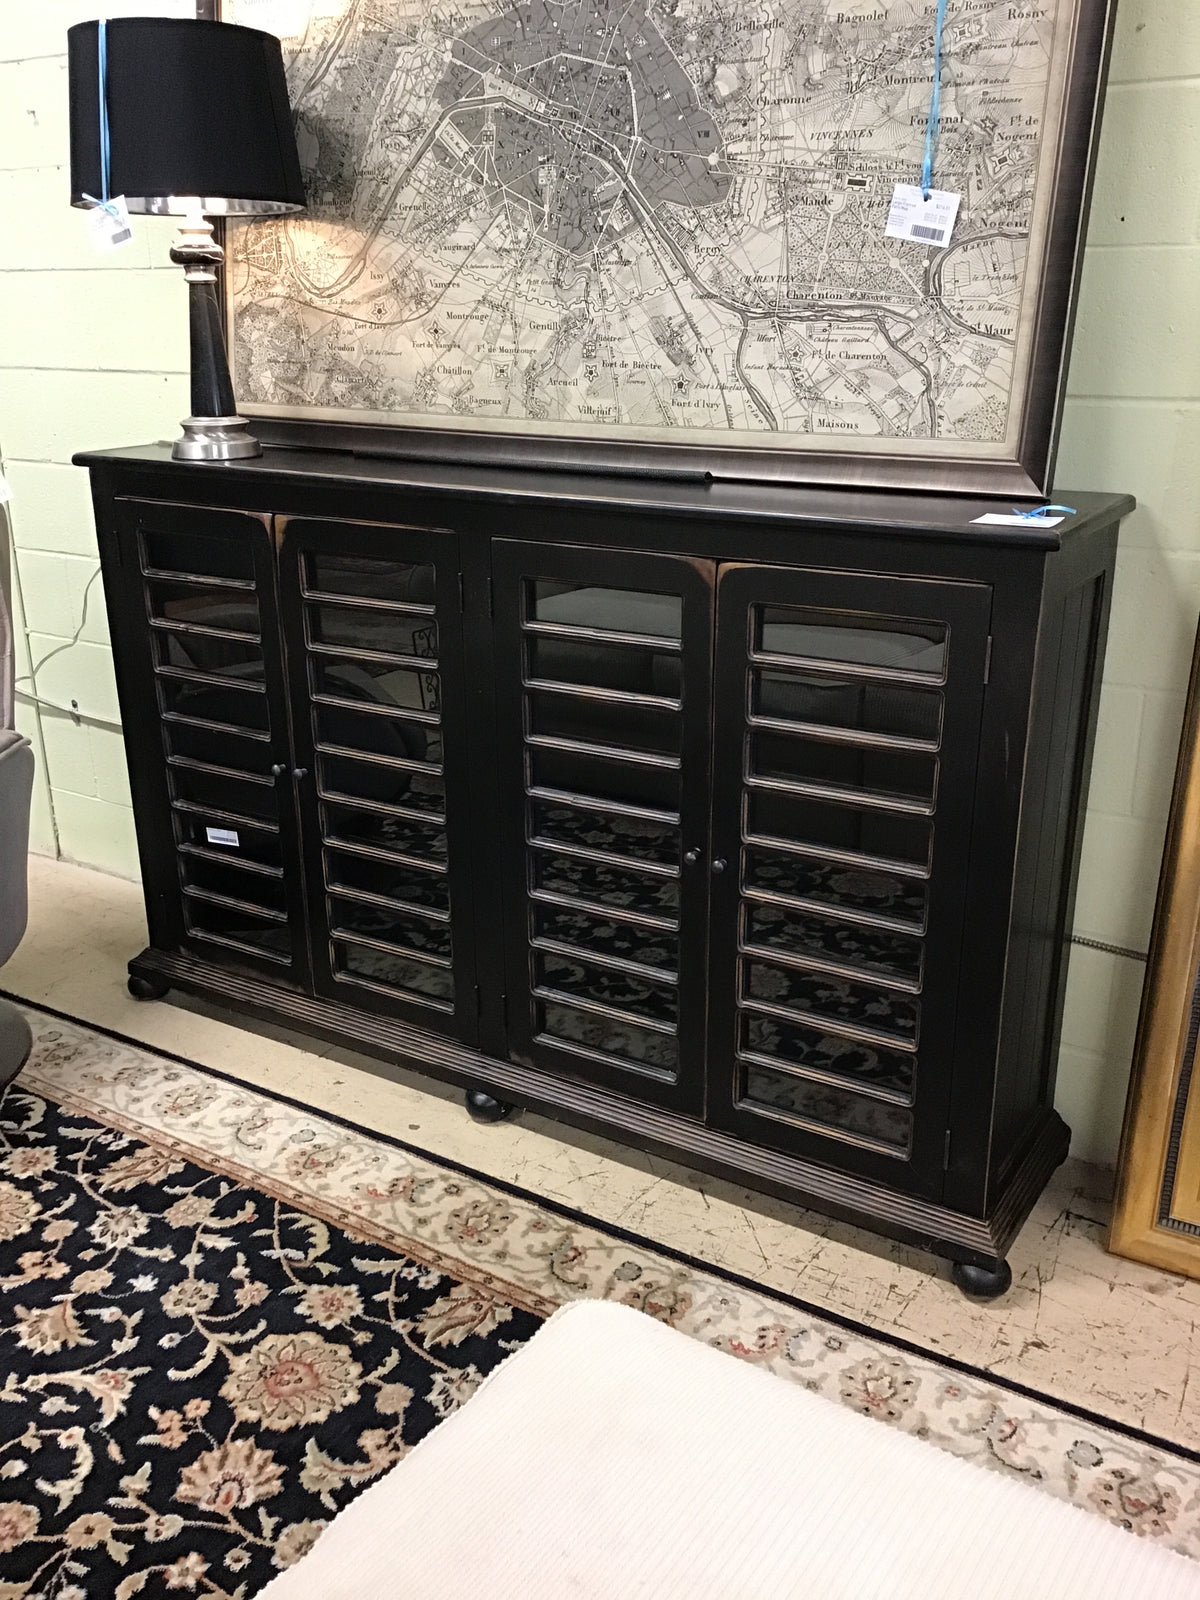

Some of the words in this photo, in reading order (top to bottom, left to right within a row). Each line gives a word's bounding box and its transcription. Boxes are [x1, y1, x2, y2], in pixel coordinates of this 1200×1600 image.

[965, 1, 997, 11] Rosny
[837, 10, 889, 28] Bagnolet
[1008, 8, 1048, 20] Rosny
[735, 19, 785, 32] Belleville
[756, 95, 812, 107] Charonne
[1025, 116, 1039, 126] de
[810, 129, 875, 141] VINCENNES
[996, 132, 1038, 144] Nogent
[399, 203, 431, 212] Grenelle
[979, 217, 1029, 230] Nogent
[438, 242, 476, 253] Vaugirard
[694, 245, 721, 256] Bercy
[961, 240, 995, 254] Marne
[370, 271, 385, 281] Issy
[739, 275, 796, 283] CHARENTON
[428, 279, 461, 289] Vanvres
[786, 289, 843, 300] Charenton
[446, 312, 489, 323] Montrouge
[529, 321, 562, 331] Gentilly
[984, 323, 1014, 335] Maur
[327, 343, 355, 351] Meudon
[499, 346, 538, 356] Montrouge
[694, 344, 715, 356] Ivry
[825, 350, 837, 360] de
[839, 350, 887, 360] Charenton
[602, 360, 617, 369] Fort
[619, 360, 629, 369] de
[437, 365, 473, 375] Châtillon
[548, 377, 578, 387] Arcueil
[469, 396, 502, 406] Bagneux
[671, 399, 692, 408] Fort
[817, 418, 859, 429] Maisons
